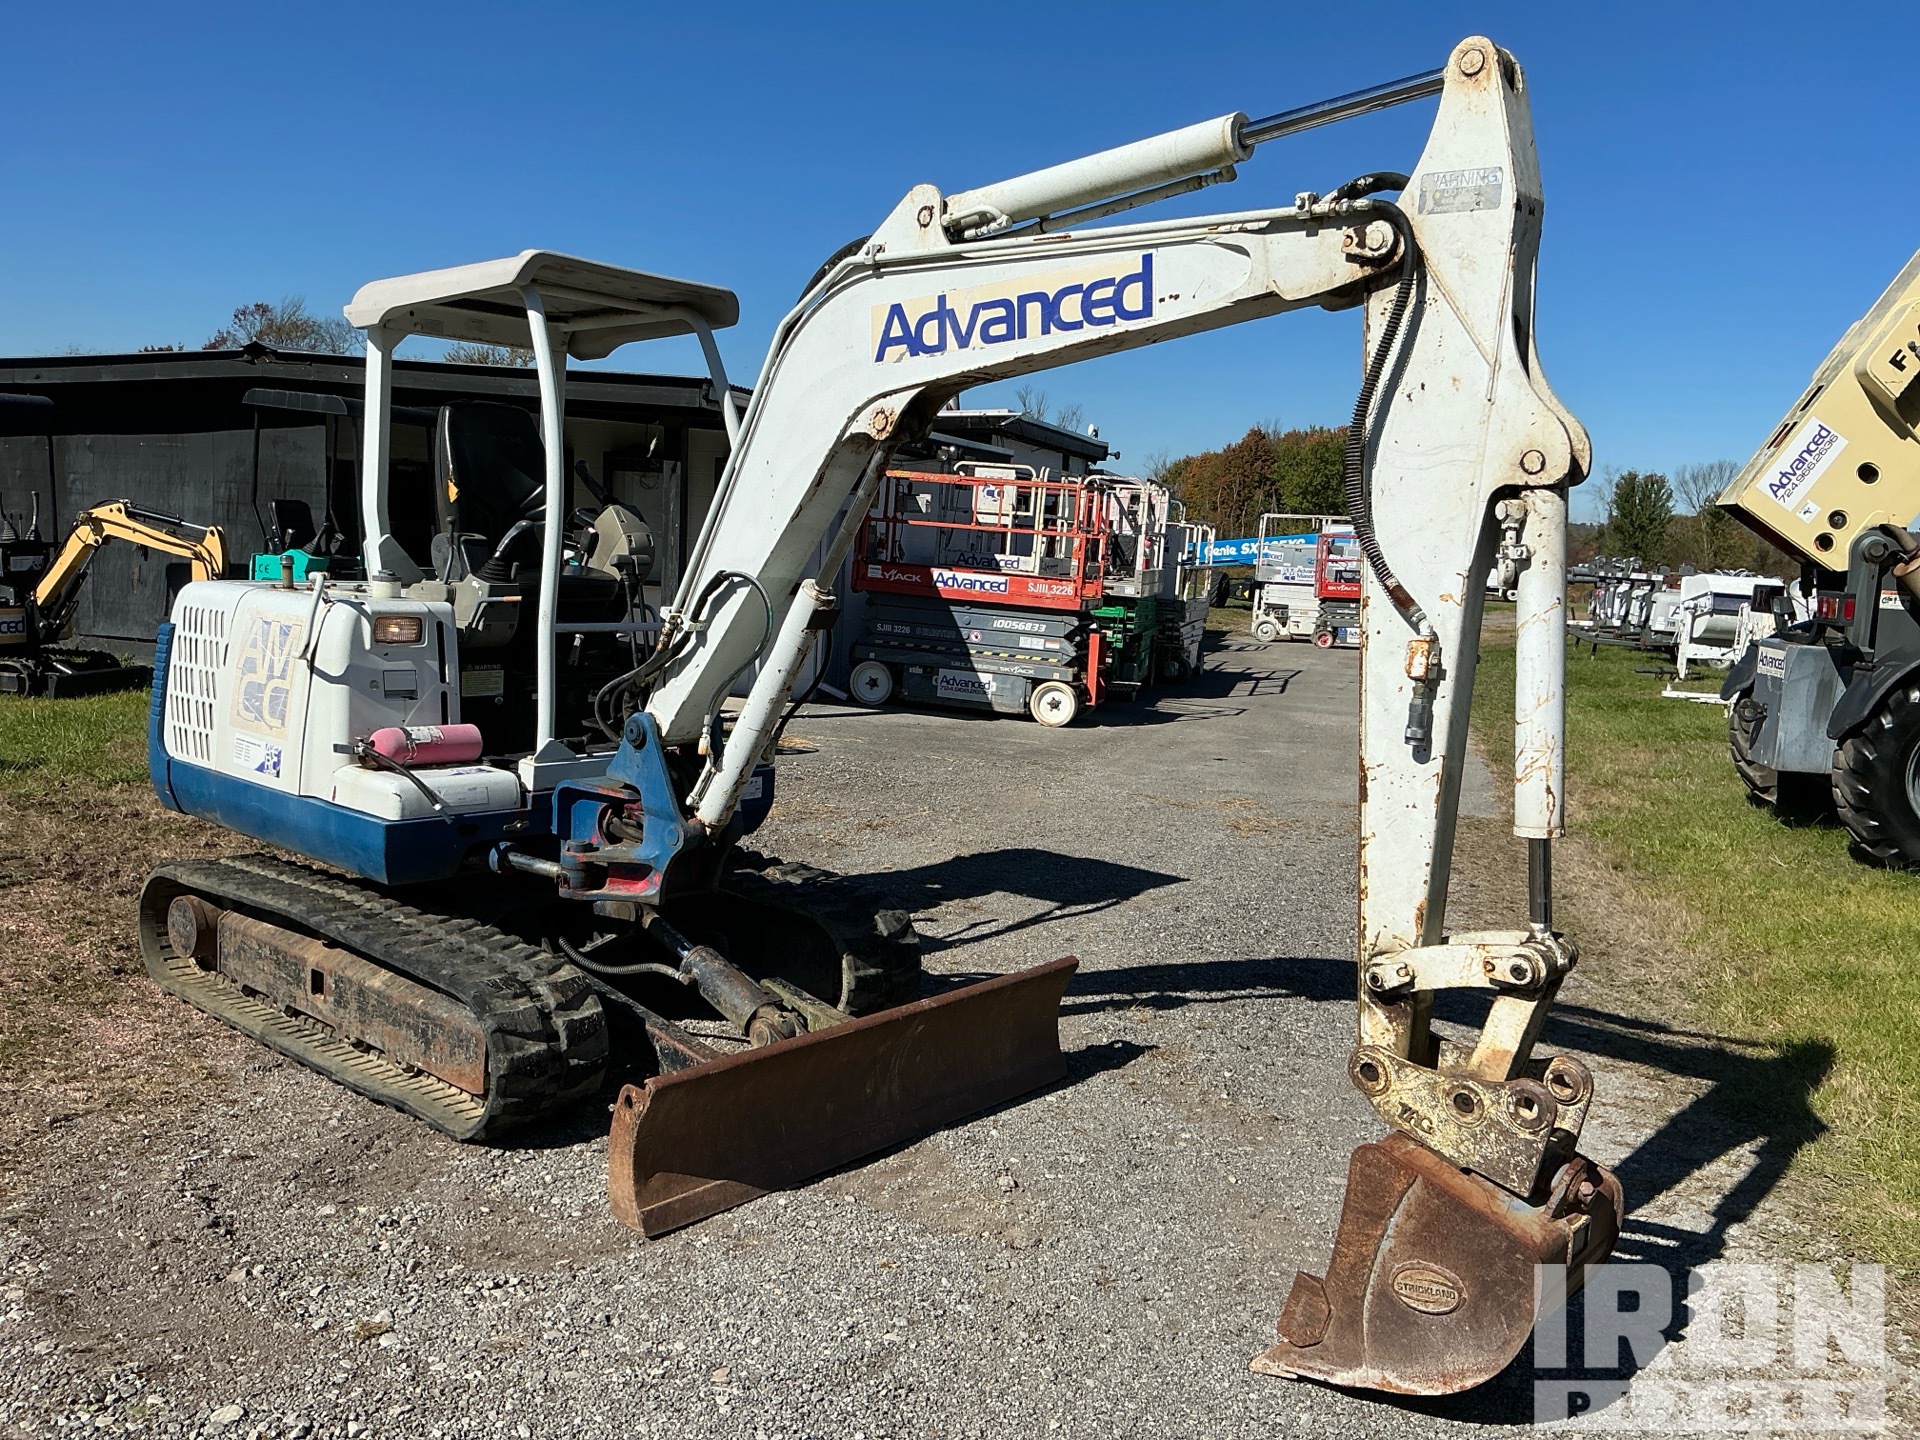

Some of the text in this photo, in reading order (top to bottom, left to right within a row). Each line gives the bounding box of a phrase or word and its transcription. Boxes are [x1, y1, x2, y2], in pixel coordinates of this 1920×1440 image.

[874, 252, 1154, 363] Advanced
[1768, 423, 1832, 499] Advanced
[1778, 433, 1839, 503] 724.966.2636
[1204, 544, 1238, 556] Genie
[956, 552, 1020, 569] Advanced
[934, 572, 1008, 593] Advanced
[1050, 584, 1073, 596] 3226
[893, 625, 911, 634] 3226
[992, 618, 1047, 633] 10056833
[999, 665, 1035, 675] SKYJACK
[940, 675, 991, 690] Advanced
[1396, 1282, 1456, 1300] STRICKLAND
